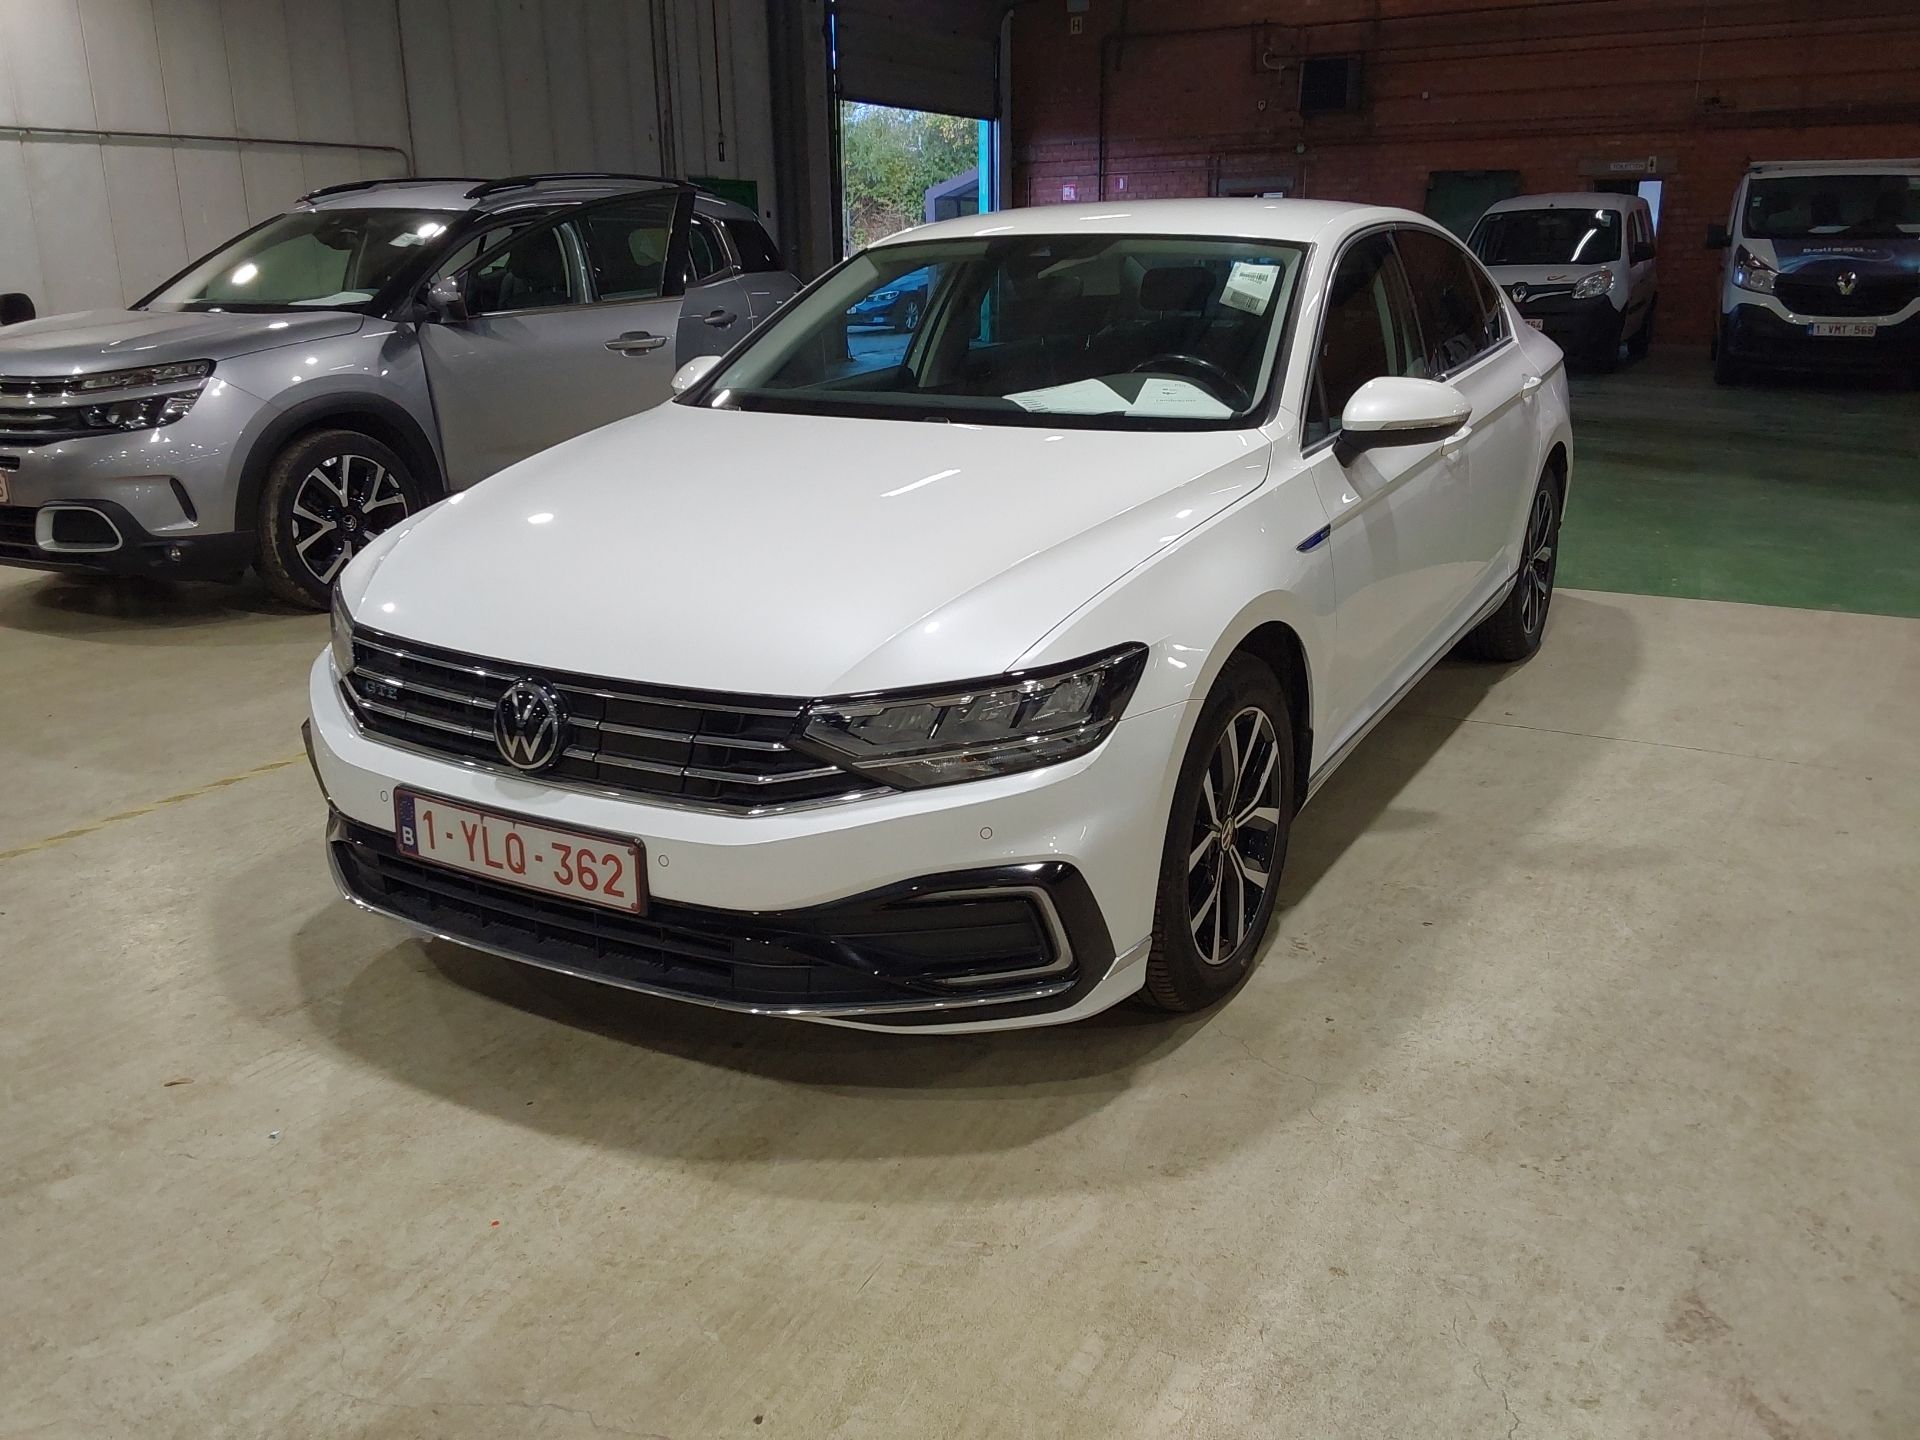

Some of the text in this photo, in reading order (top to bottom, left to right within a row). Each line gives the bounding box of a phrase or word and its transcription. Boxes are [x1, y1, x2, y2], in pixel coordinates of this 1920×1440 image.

[365, 680, 398, 700] GTE
[402, 826, 415, 846] B
[422, 810, 624, 898] 1-YLQ-362
